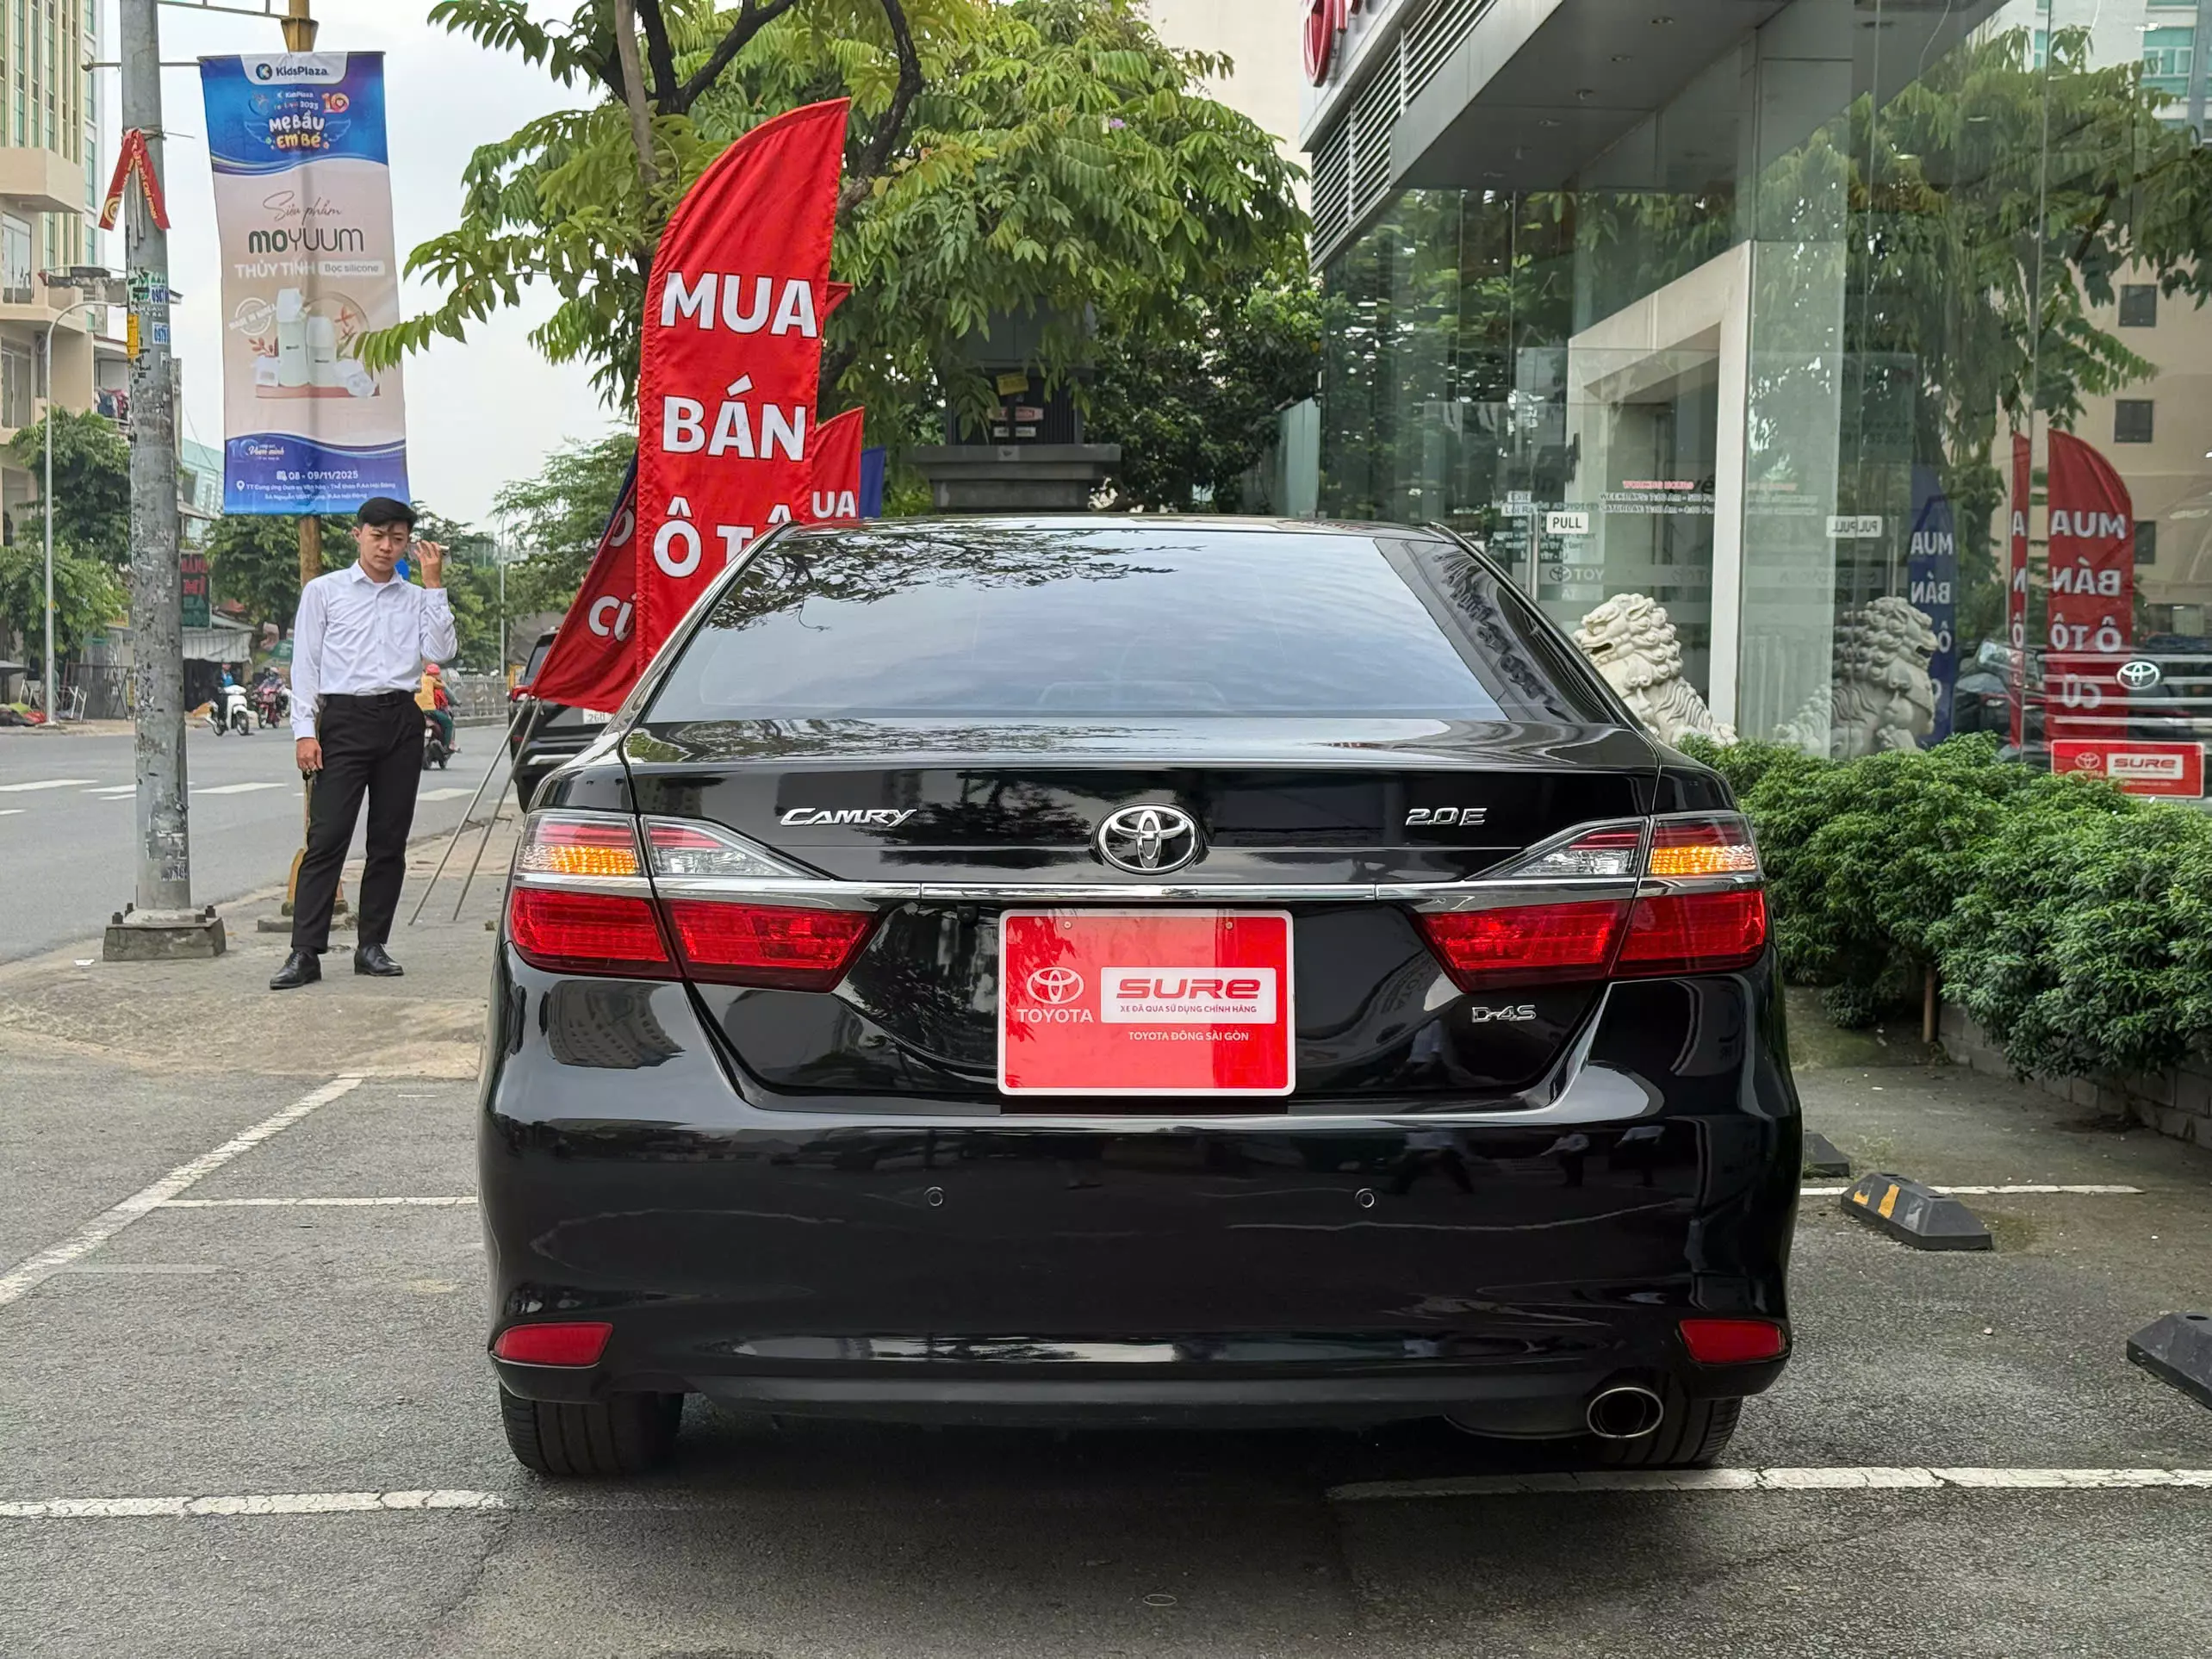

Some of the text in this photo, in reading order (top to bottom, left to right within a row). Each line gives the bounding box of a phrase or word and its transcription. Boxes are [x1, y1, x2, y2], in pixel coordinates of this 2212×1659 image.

[276, 65, 328, 77] KidsPlaza
[325, 264, 379, 274] Bọc silicone
[660, 271, 818, 339] MUA
[662, 373, 807, 462] BÁN
[289, 471, 300, 481] 08
[308, 470, 358, 481] 09/11/2025
[1552, 517, 1582, 529] PULL
[653, 496, 703, 579] Ô
[2114, 757, 2176, 769] SURE
[780, 808, 917, 827] CAMRY
[1116, 979, 1261, 999] SURE
[1016, 1009, 1095, 1023] TOYOTA
[1133, 1003, 1145, 1013] ĐÃ
[1146, 1005, 1164, 1014] QUA
[1178, 1005, 1202, 1016] DỤNG
[1204, 1003, 1231, 1013] CHÍNH
[1471, 1004, 1537, 1022] D-4S
[1128, 1028, 1249, 1041] TOYOTA ĐÔNG SÀI GÒN
